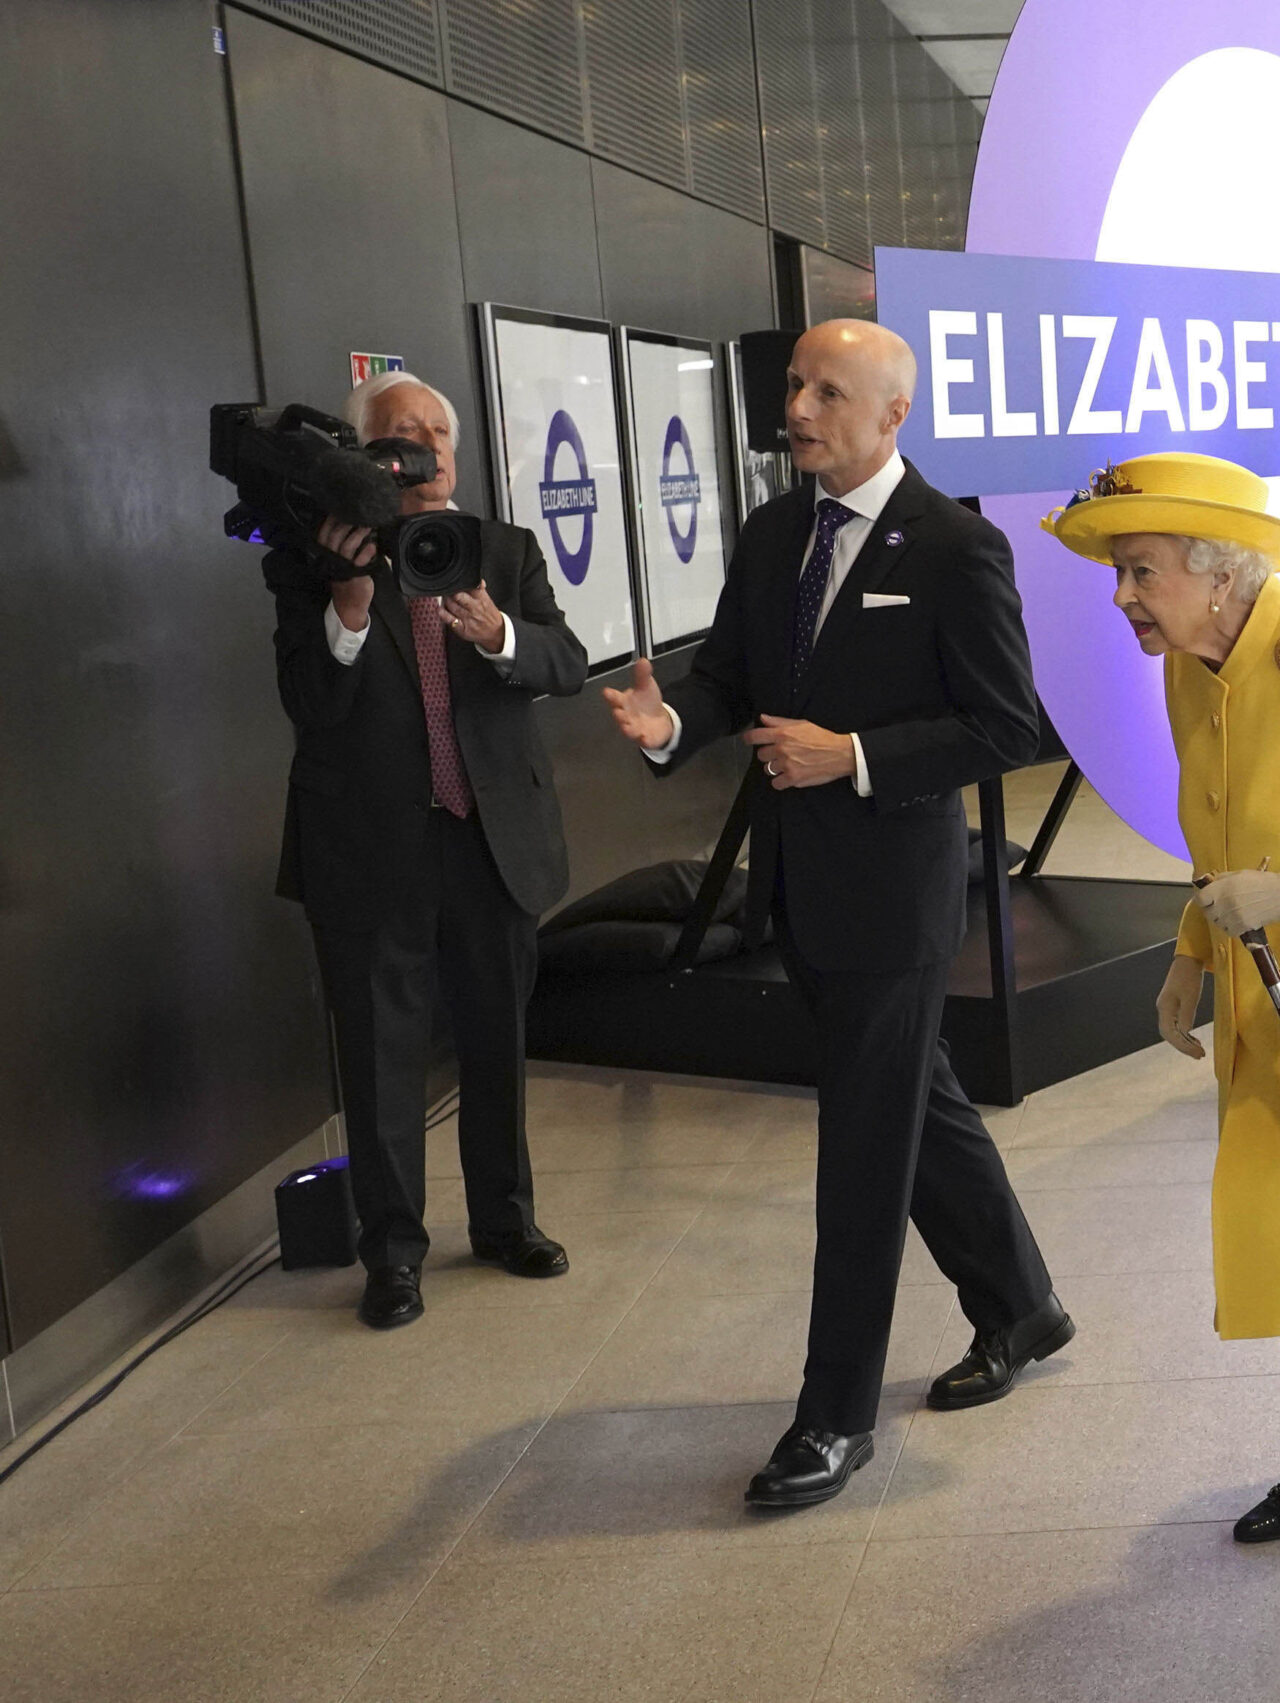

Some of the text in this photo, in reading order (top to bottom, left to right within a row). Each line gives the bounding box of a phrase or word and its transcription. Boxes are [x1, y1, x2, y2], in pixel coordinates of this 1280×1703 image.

[542, 486, 595, 511] ELIZABETH LINE
[661, 481, 688, 500] ELIZABETH
